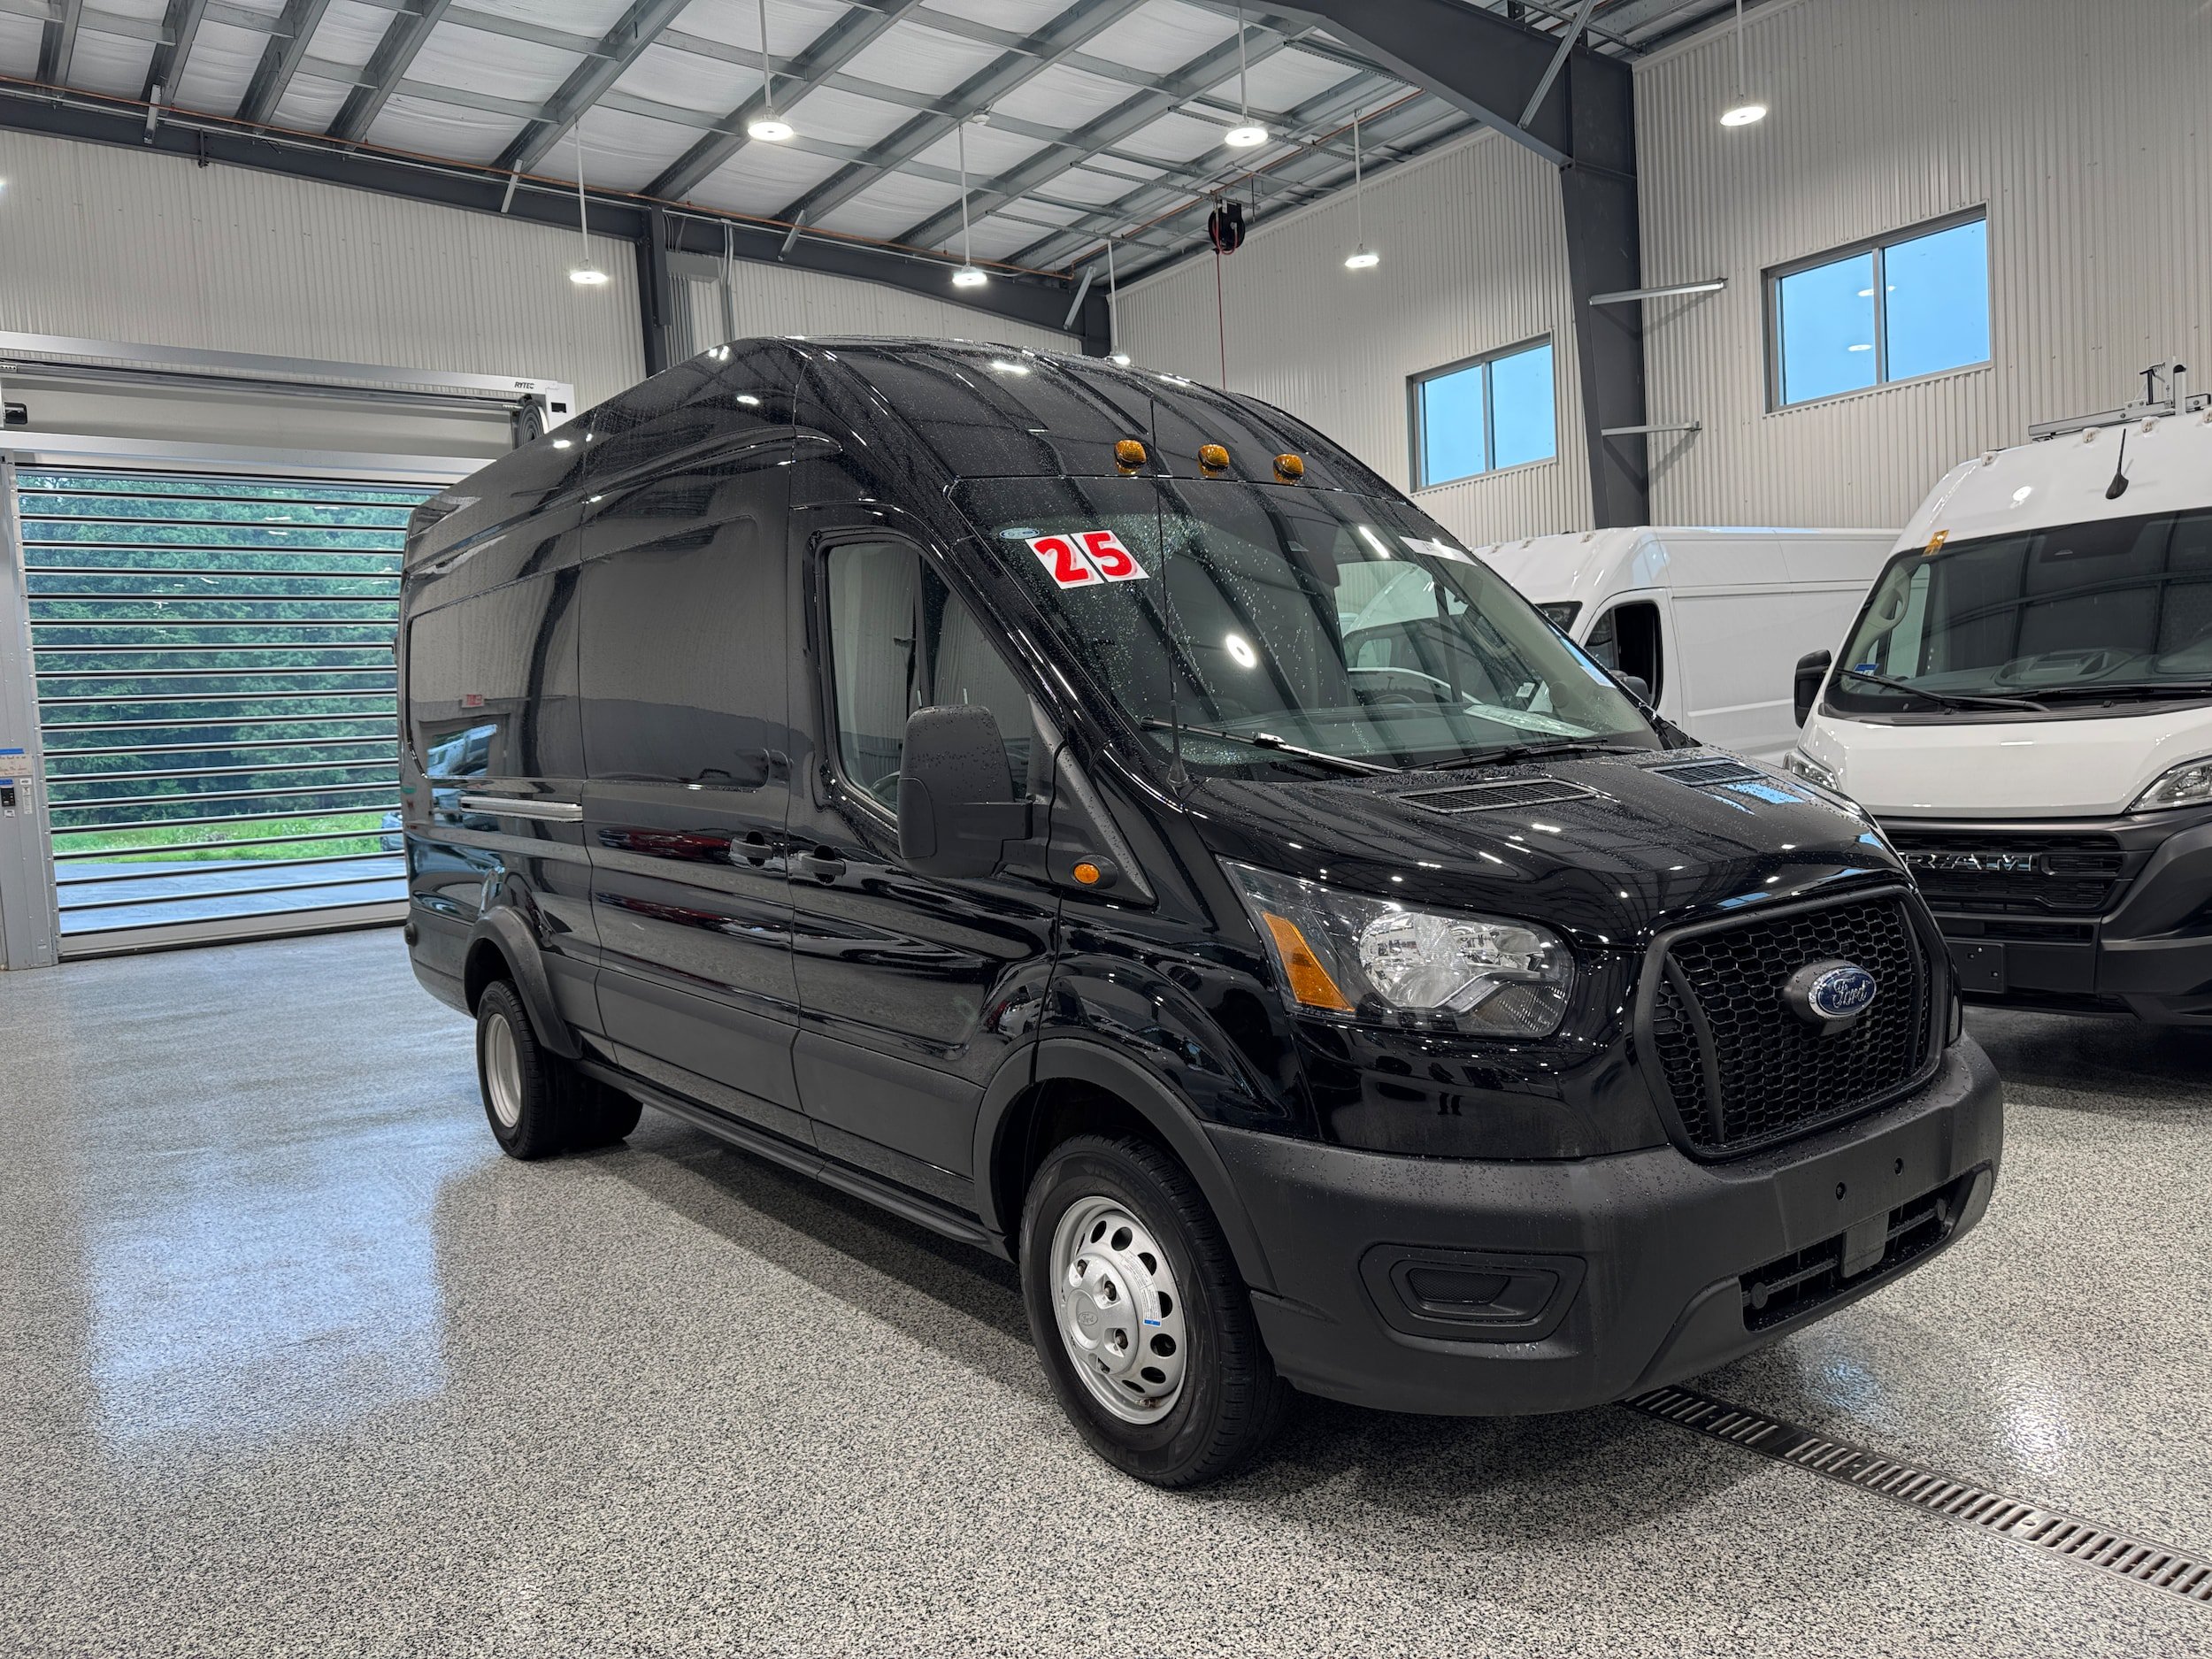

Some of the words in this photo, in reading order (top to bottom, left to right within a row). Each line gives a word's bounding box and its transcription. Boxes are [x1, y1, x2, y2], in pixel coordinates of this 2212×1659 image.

[1033, 533, 1135, 582] 25
[1898, 853, 2032, 872] RAM
[1832, 976, 1869, 1008] Ford
